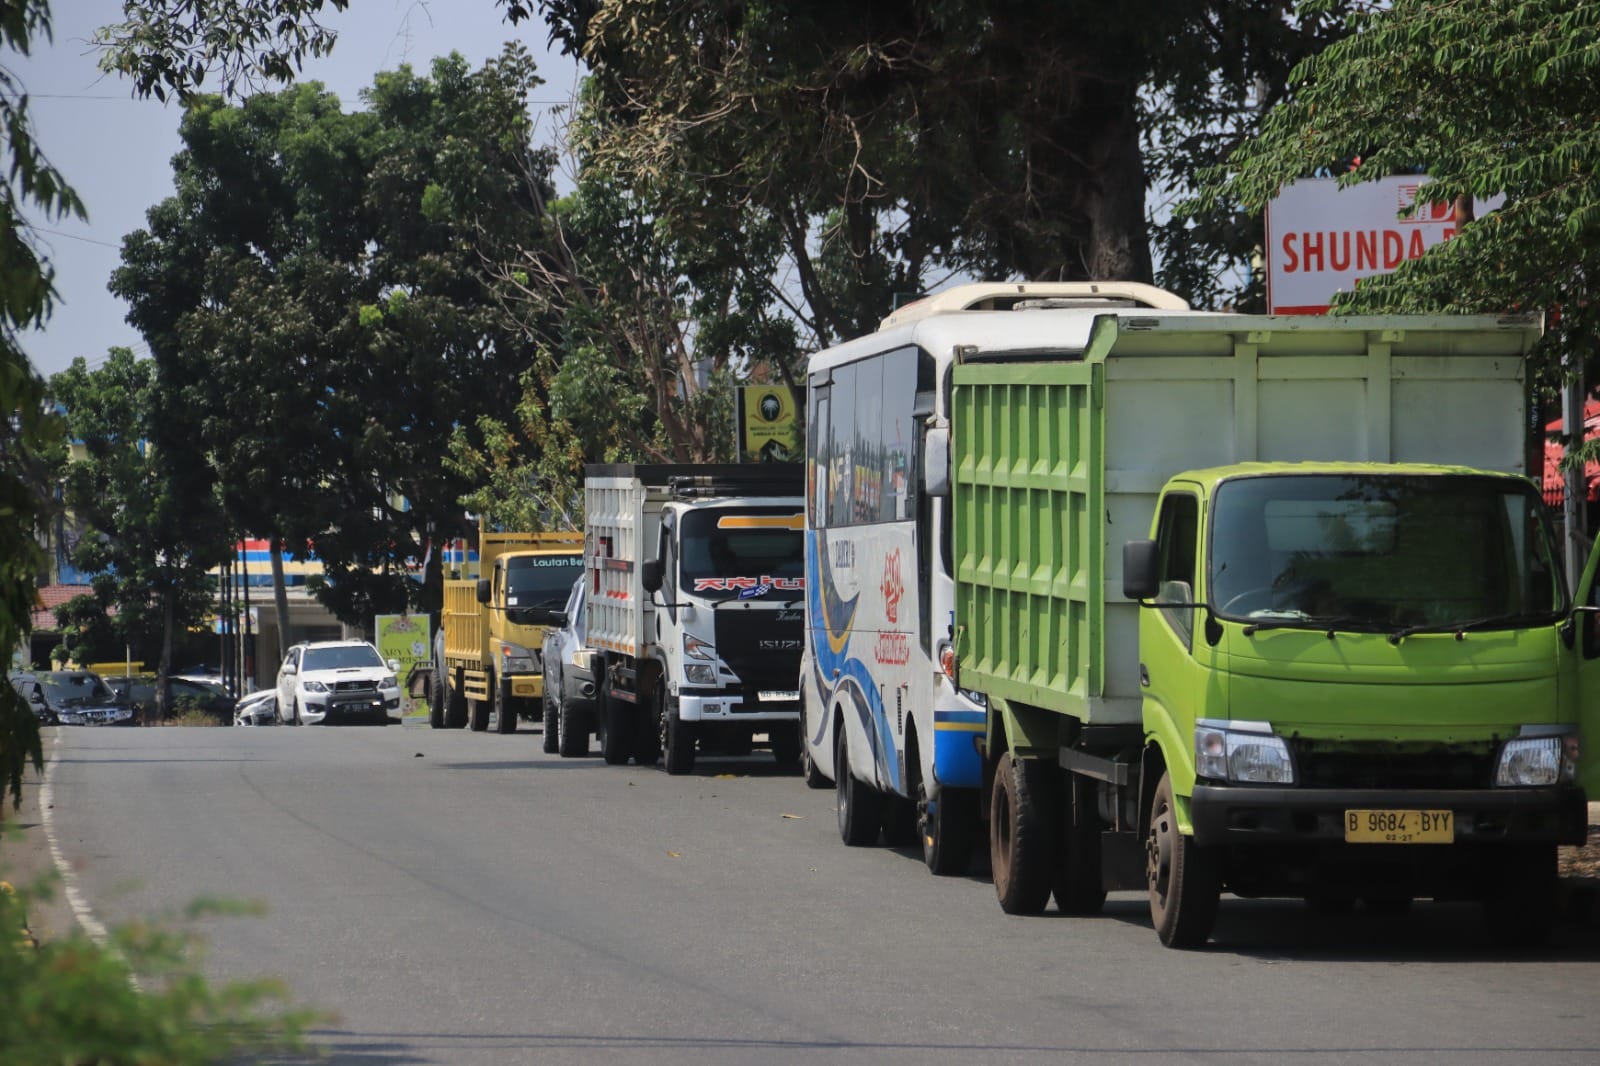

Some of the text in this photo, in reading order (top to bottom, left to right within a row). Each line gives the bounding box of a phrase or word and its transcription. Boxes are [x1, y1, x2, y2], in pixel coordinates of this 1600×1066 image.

[1282, 229, 1425, 273] SHUNDA
[533, 558, 569, 567] Lautan
[1349, 812, 1450, 831] B 9684 BYY
